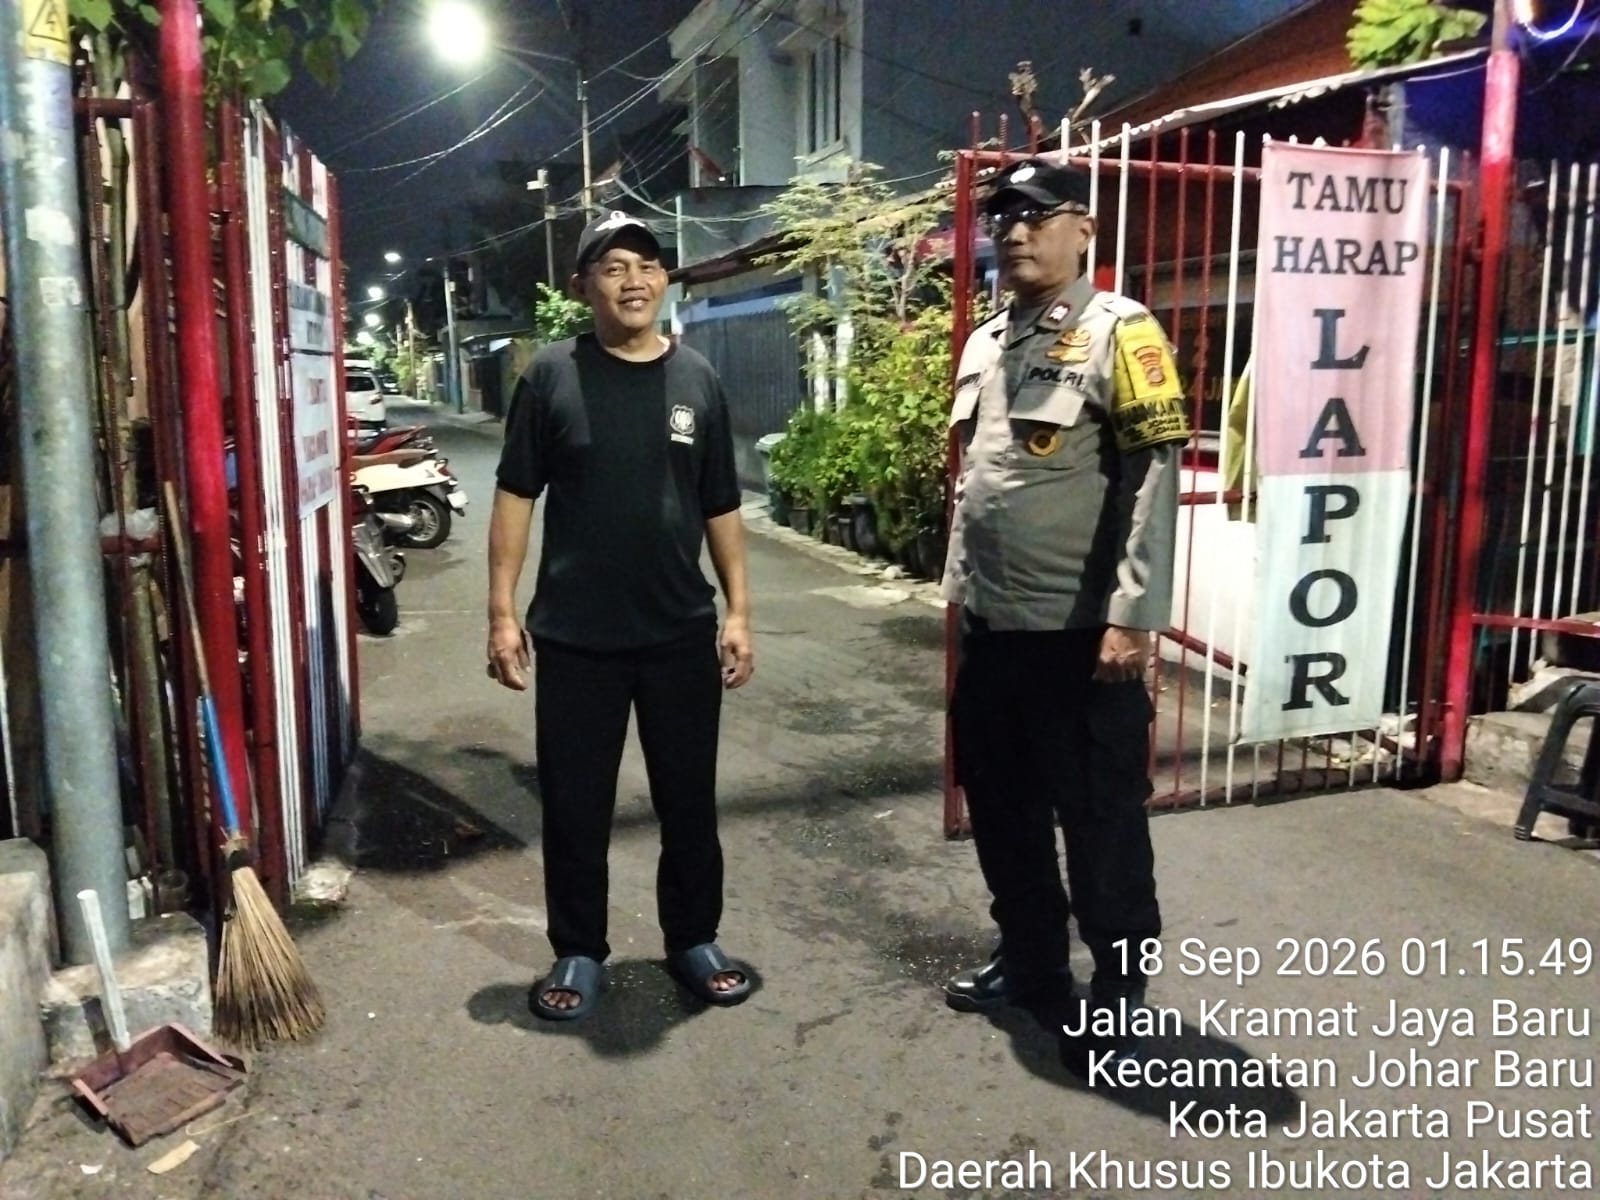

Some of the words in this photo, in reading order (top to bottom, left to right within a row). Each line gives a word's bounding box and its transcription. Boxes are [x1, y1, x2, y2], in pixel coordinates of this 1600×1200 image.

[1287, 171, 1408, 215] TAMU
[1271, 235, 1420, 277] HARAP
[1029, 366, 1085, 387] POLRI
[1281, 308, 1370, 711] LAPOR
